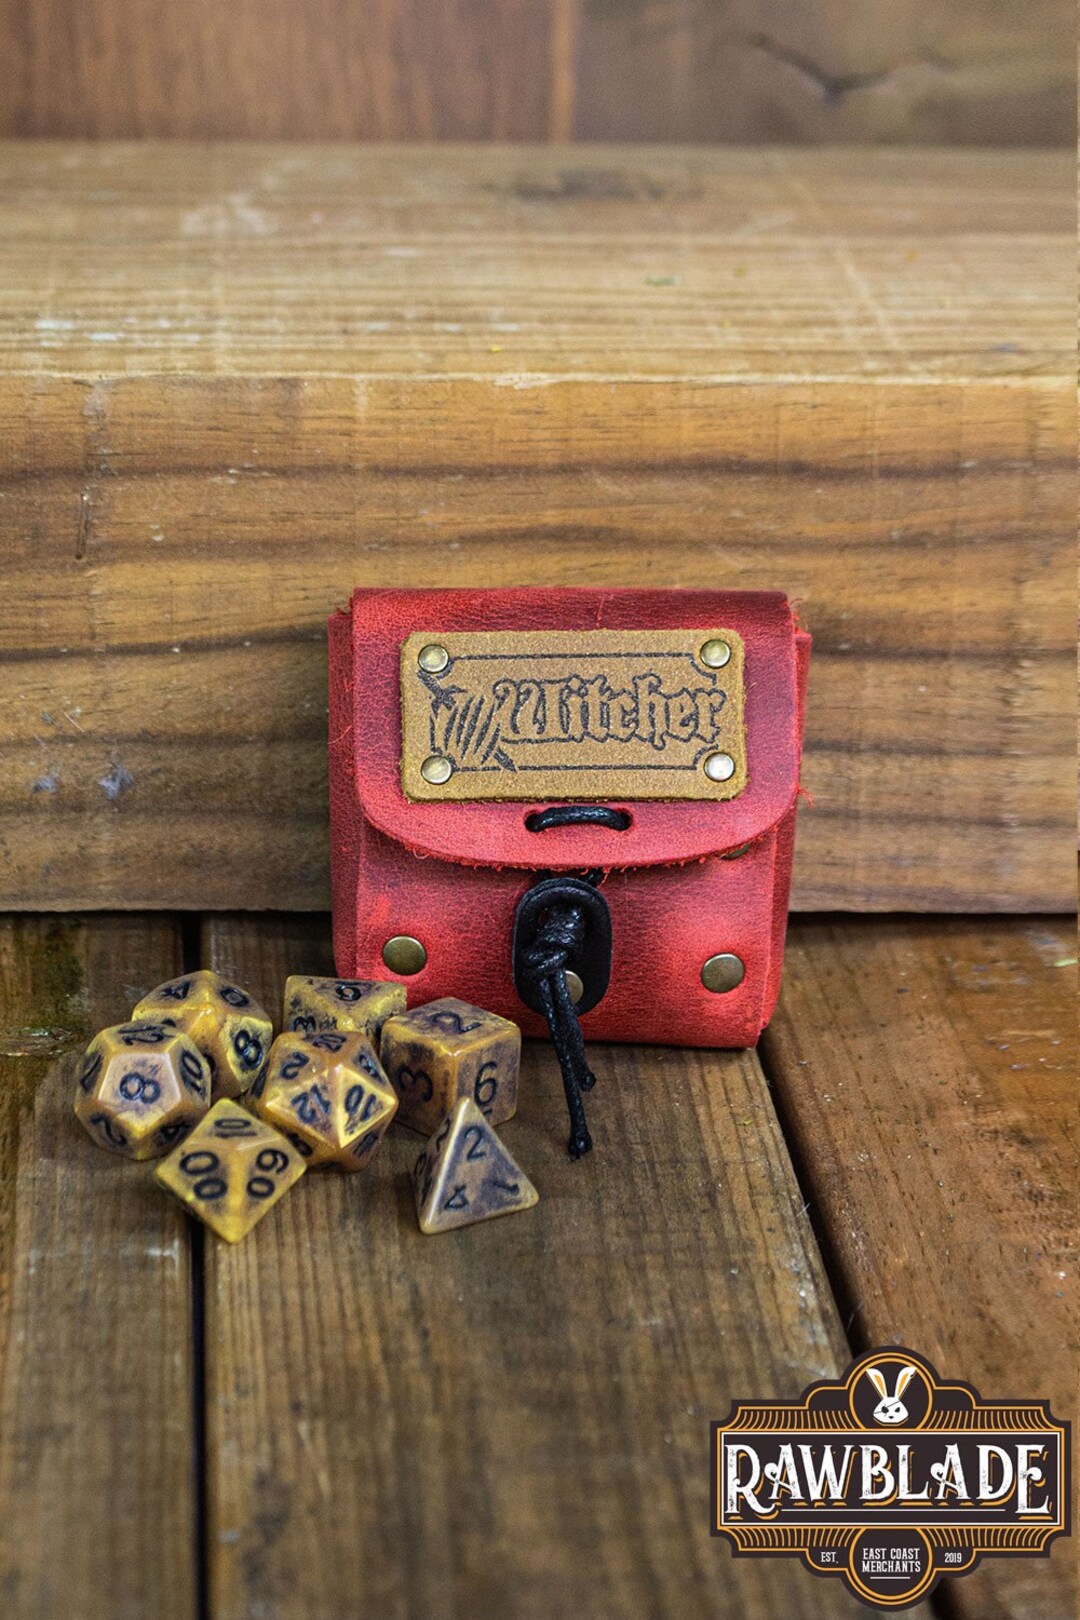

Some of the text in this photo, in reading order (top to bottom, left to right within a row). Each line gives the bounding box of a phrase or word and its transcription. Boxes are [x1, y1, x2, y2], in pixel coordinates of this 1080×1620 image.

[492, 672, 728, 751] Witcher
[234, 1028, 265, 1071] 8
[118, 1071, 162, 1105] 8
[397, 1065, 433, 1103] 3
[473, 1060, 498, 1107] 6
[463, 1125, 487, 1162] 2
